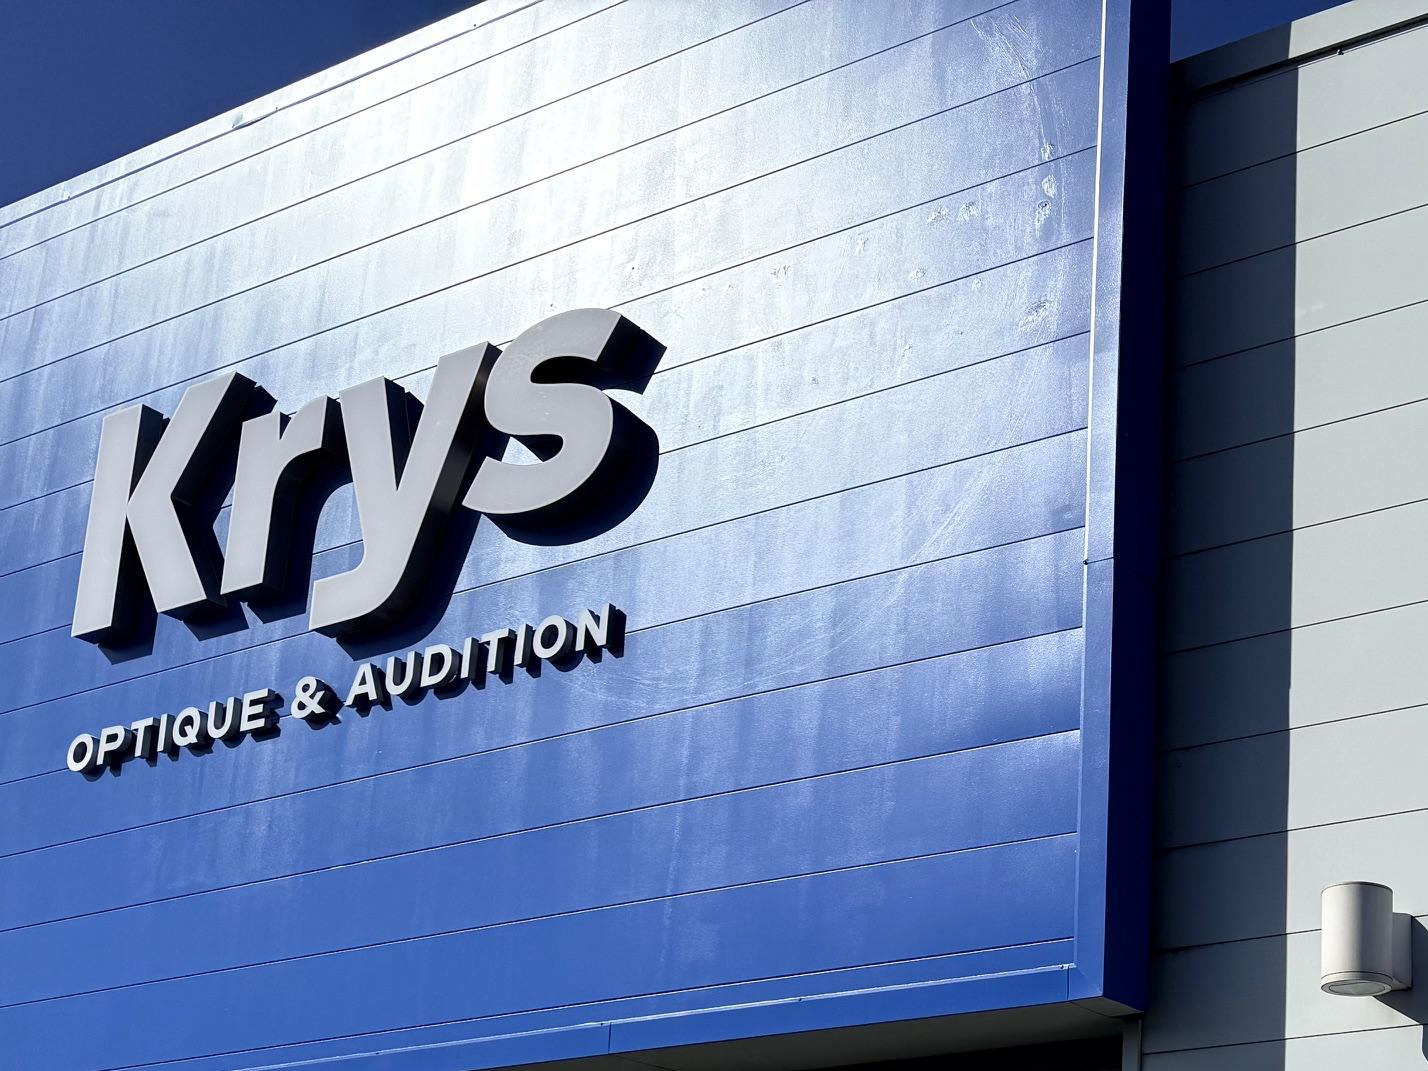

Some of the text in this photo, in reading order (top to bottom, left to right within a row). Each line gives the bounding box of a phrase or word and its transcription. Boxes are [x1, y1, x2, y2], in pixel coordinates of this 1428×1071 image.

[71, 307, 650, 638] Krys
[66, 603, 616, 773] OPTIQUE & AUDITION
